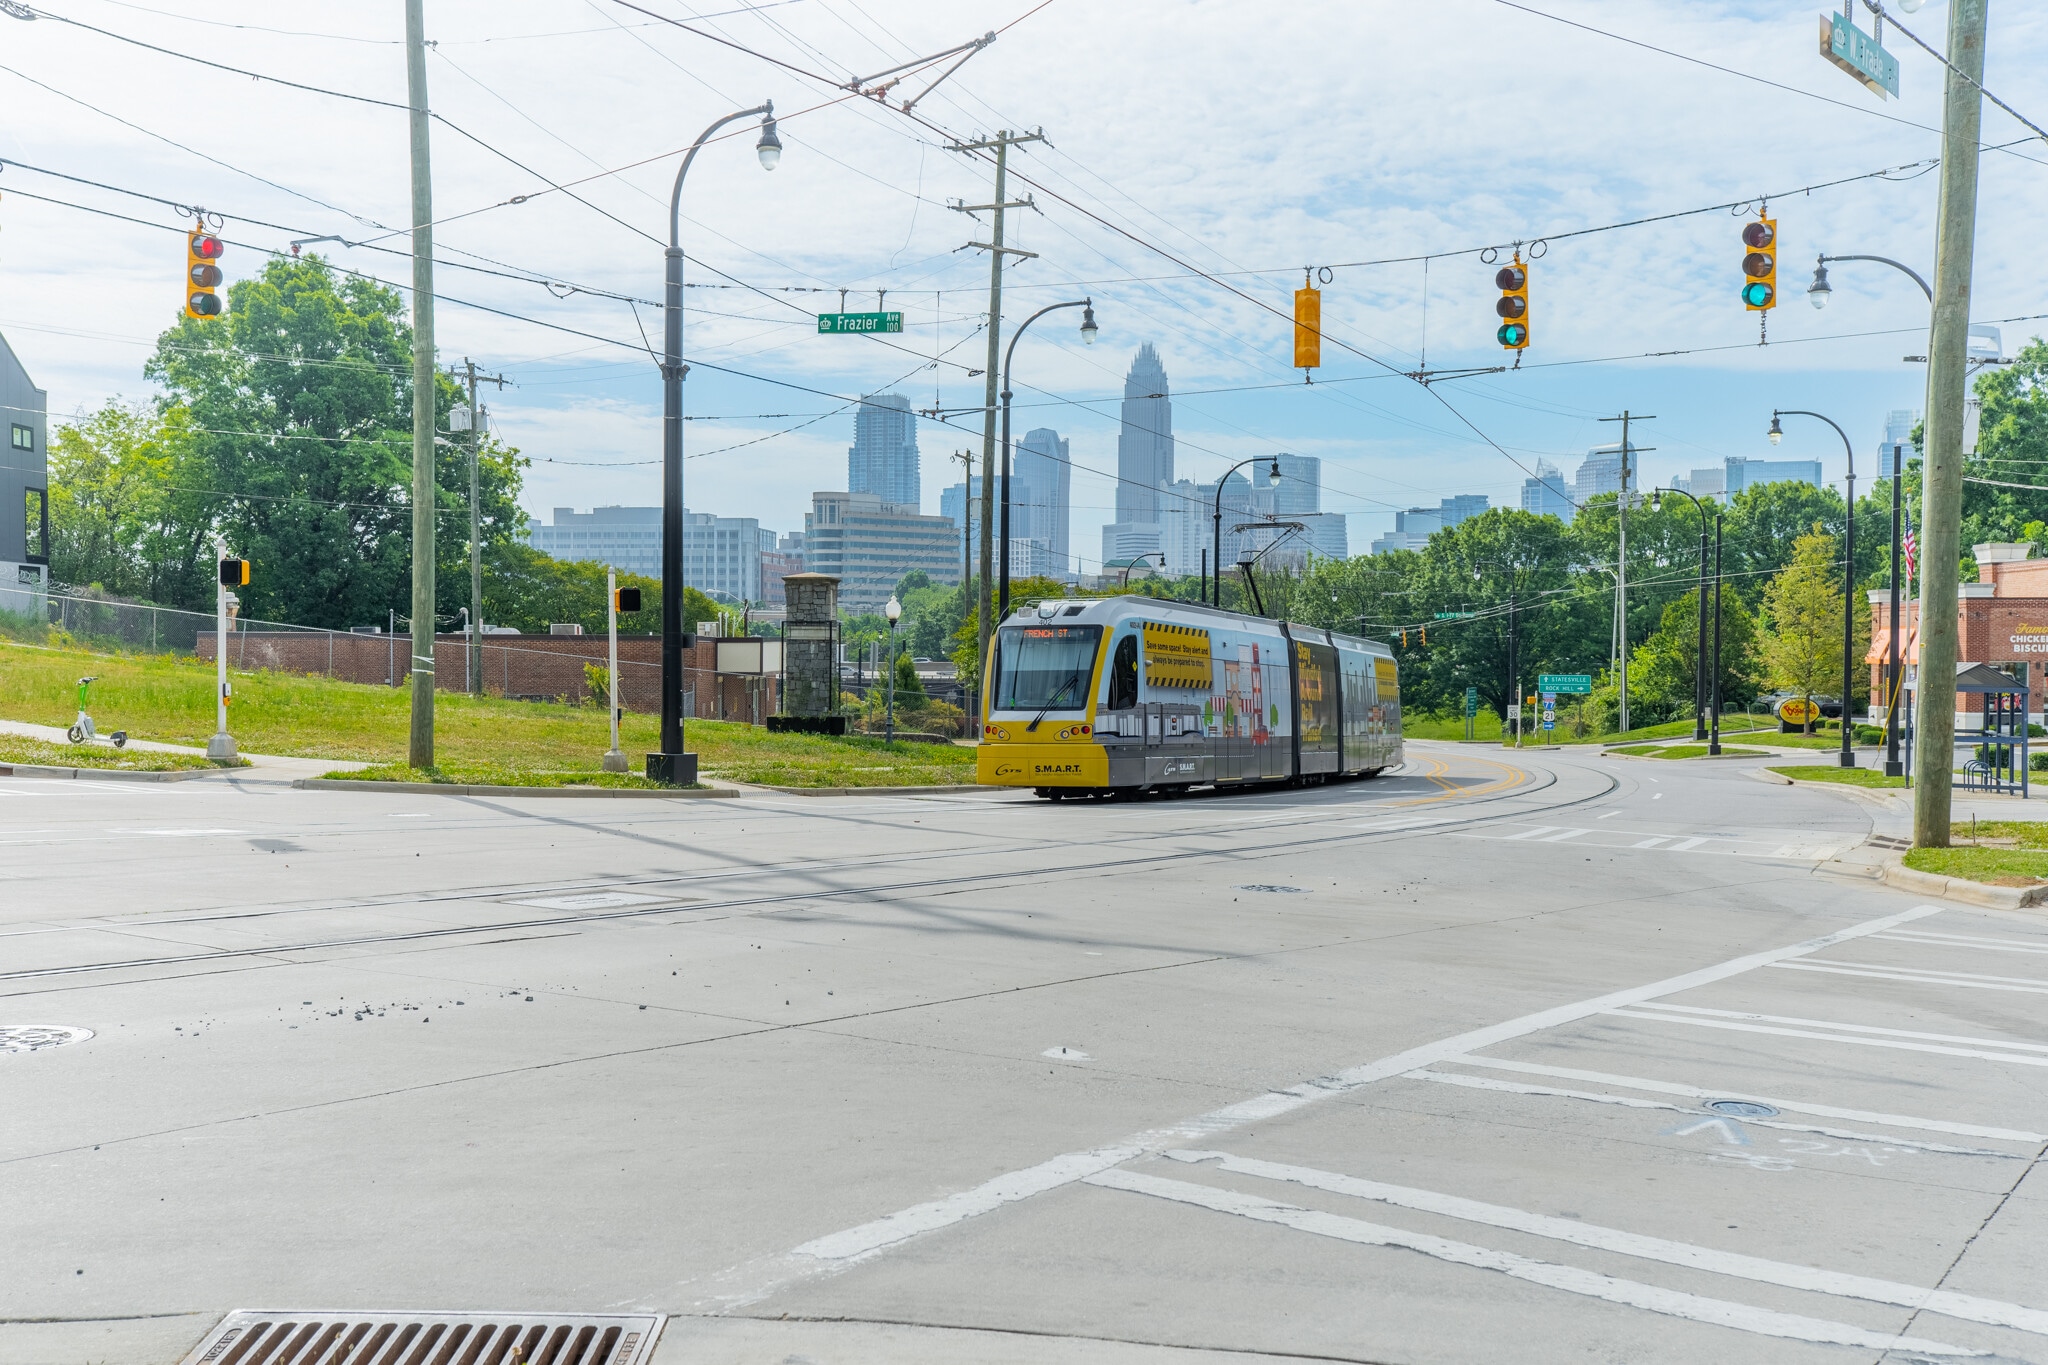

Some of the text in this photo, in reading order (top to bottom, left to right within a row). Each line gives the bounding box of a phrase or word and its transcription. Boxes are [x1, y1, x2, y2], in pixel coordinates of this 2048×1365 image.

[1849, 29, 1859, 62] W.
[1861, 38, 1884, 80] Trade
[837, 315, 879, 331] Frazier
[886, 312, 899, 322] Ave
[886, 322, 899, 332] 100
[1023, 628, 1071, 639] FRENCH ST.
[1146, 640, 1209, 655] Save some space! Stay alert and
[1297, 642, 1311, 665] Stay
[1152, 655, 1167, 666] always
[1167, 656, 1173, 665] be
[1173, 657, 1191, 668] prepared
[1301, 702, 1313, 721] Rail
[1034, 765, 1082, 773] S.M.A.R.T.
